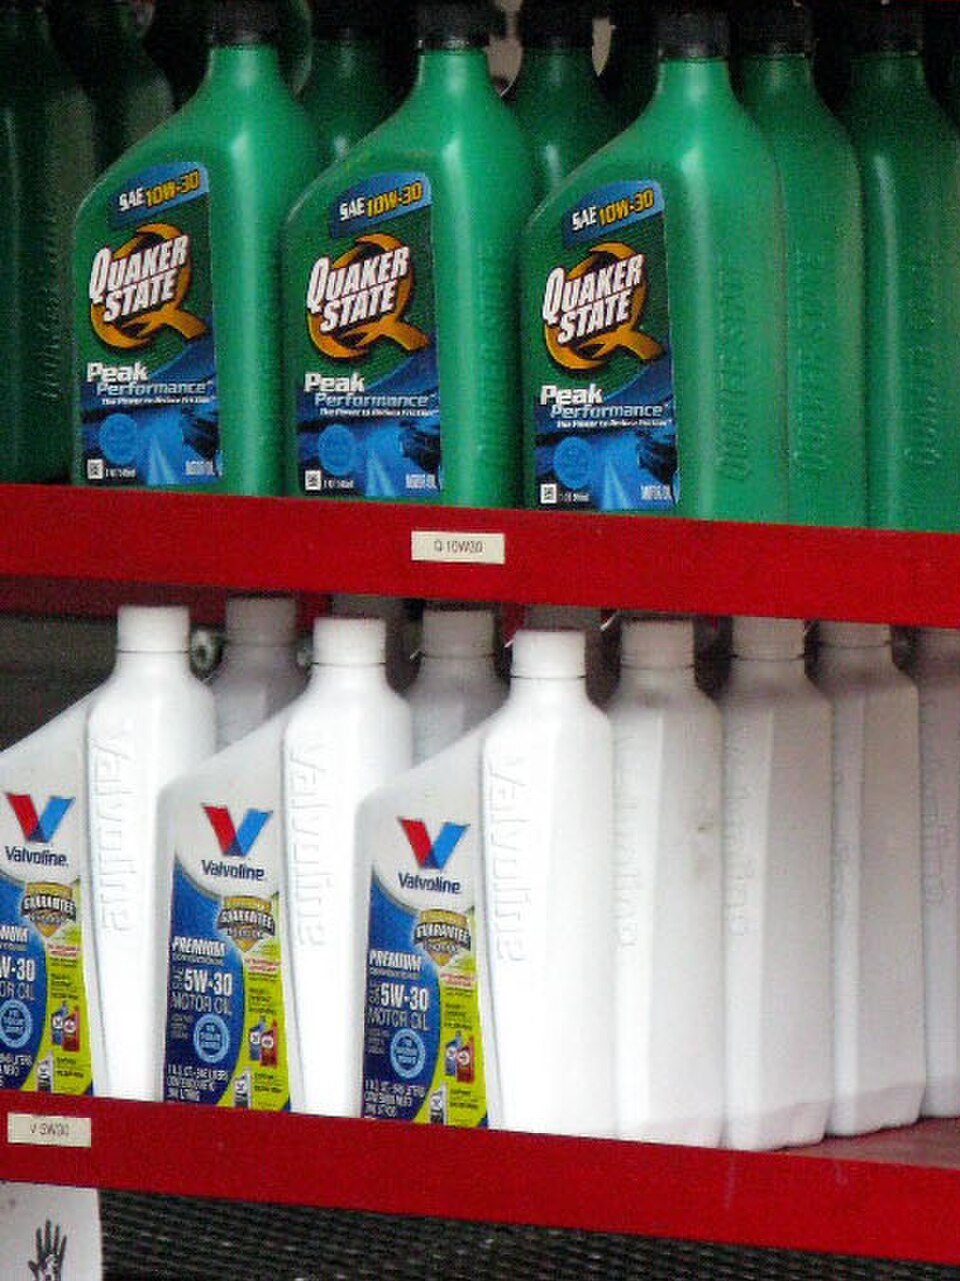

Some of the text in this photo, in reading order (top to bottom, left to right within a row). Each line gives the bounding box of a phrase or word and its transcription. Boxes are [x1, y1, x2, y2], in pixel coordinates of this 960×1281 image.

[118, 170, 200, 212] SAE 10W-30
[339, 181, 422, 221] SAE 10W-30
[572, 189, 654, 231] SAE 10W-30
[89, 234, 189, 305] QUAKER
[306, 246, 410, 314] QUAKER
[103, 268, 179, 322] STATE
[543, 254, 646, 325] QUAKER
[320, 280, 397, 333] STATE
[557, 288, 633, 345] STATE
[87, 362, 149, 383] Peak
[304, 373, 365, 393] Peak
[96, 381, 209, 397] Performance
[314, 392, 430, 408] Performance
[540, 384, 603, 406] Peak
[550, 403, 664, 419] Performance
[5, 845, 68, 867] Valvoline
[201, 859, 265, 881] Valvoline
[398, 873, 461, 895] Valvoline
[184, 968, 233, 996] 5W-30
[381, 982, 429, 1011] 5W-30
